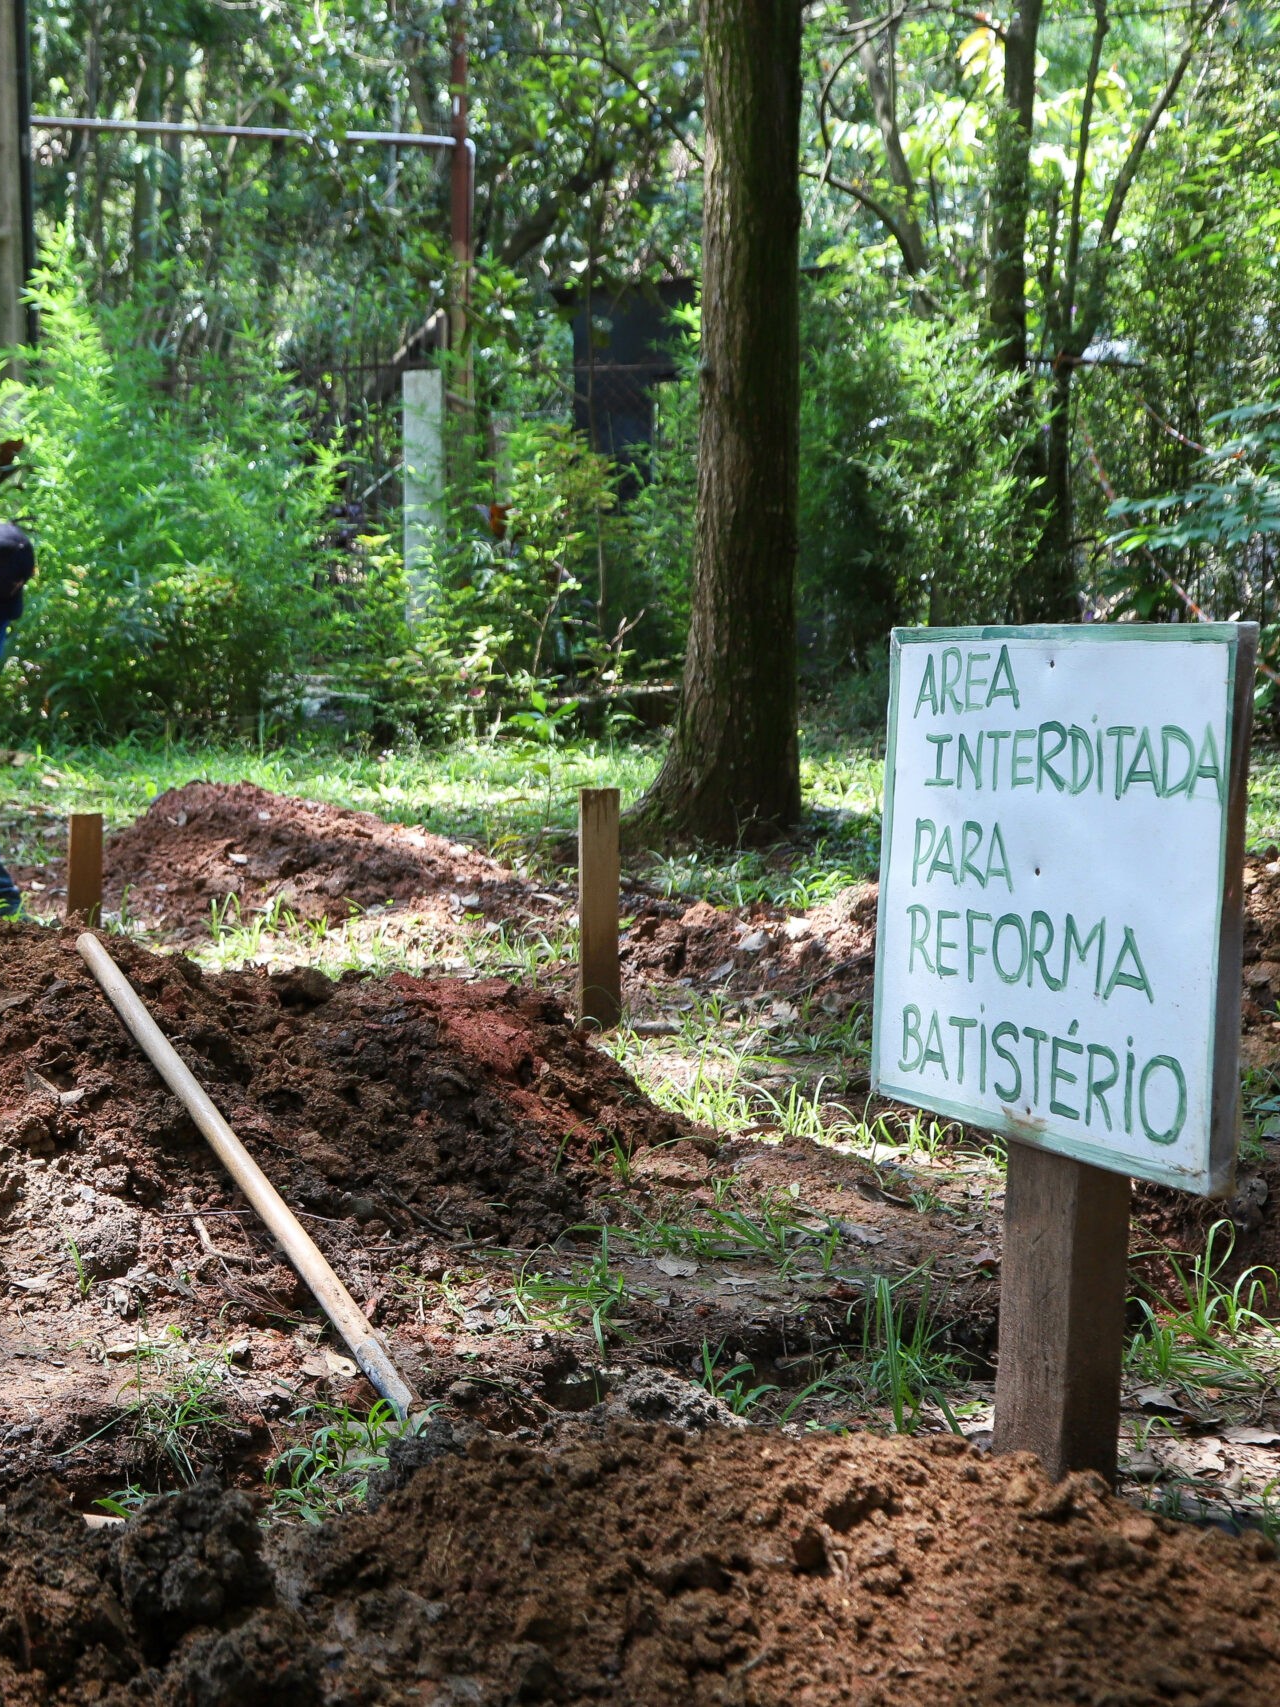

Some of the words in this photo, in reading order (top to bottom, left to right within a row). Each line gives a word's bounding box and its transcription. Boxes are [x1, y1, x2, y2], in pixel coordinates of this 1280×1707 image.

[914, 644, 1020, 718] AREA
[924, 714, 1224, 800] INTERDITADA
[911, 817, 1014, 892] PARA
[906, 904, 1154, 1003] REFORMA
[898, 1003, 1187, 1145] BATISTÉRIO
